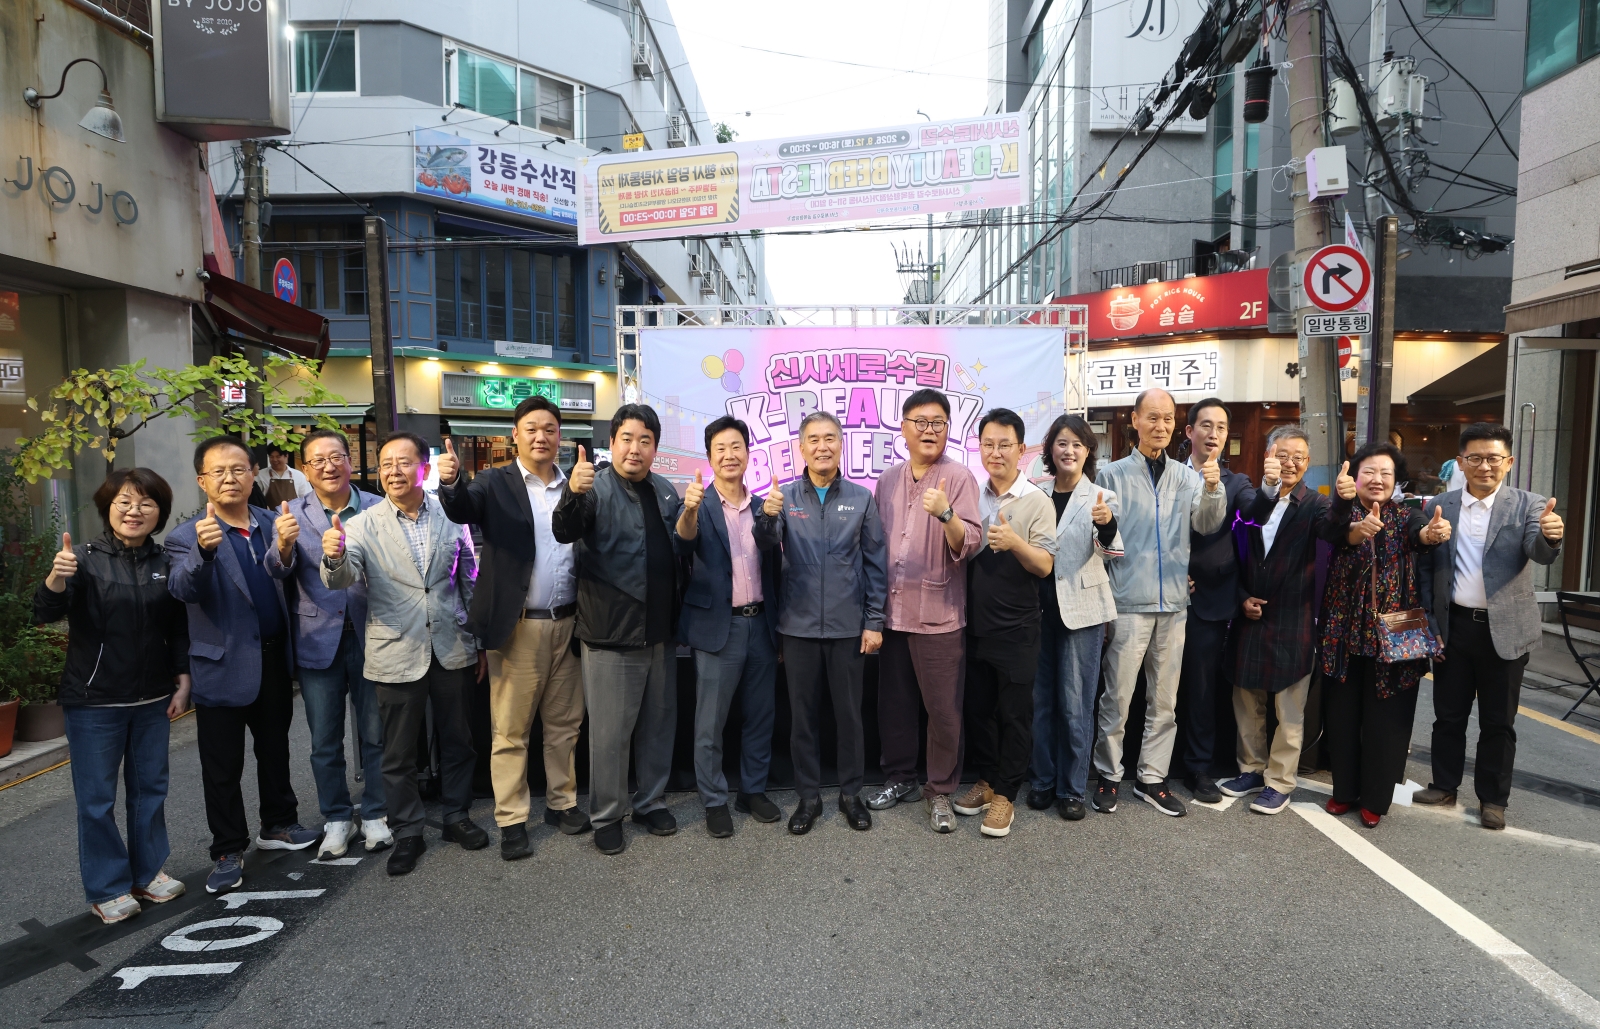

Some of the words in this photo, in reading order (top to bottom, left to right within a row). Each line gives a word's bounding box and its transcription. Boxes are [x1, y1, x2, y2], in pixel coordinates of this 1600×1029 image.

[205, 0, 262, 12] JOJO
[478, 146, 576, 194] 강동수산직
[13, 157, 138, 225] JOJO
[484, 180, 498, 191] 오늘
[500, 184, 515, 195] 새벽
[517, 187, 531, 199] 경매
[532, 190, 549, 203] 직송!
[1150, 295, 1163, 309] POT
[1164, 287, 1181, 297] RICE
[1182, 287, 1206, 303] HOUSE
[1240, 301, 1263, 320] 2F
[1308, 316, 1367, 333] 일방통행
[771, 353, 946, 389] 신사세로수길
[1097, 360, 1202, 390] 금별맥주
[730, 388, 978, 446] K-BEAUY
